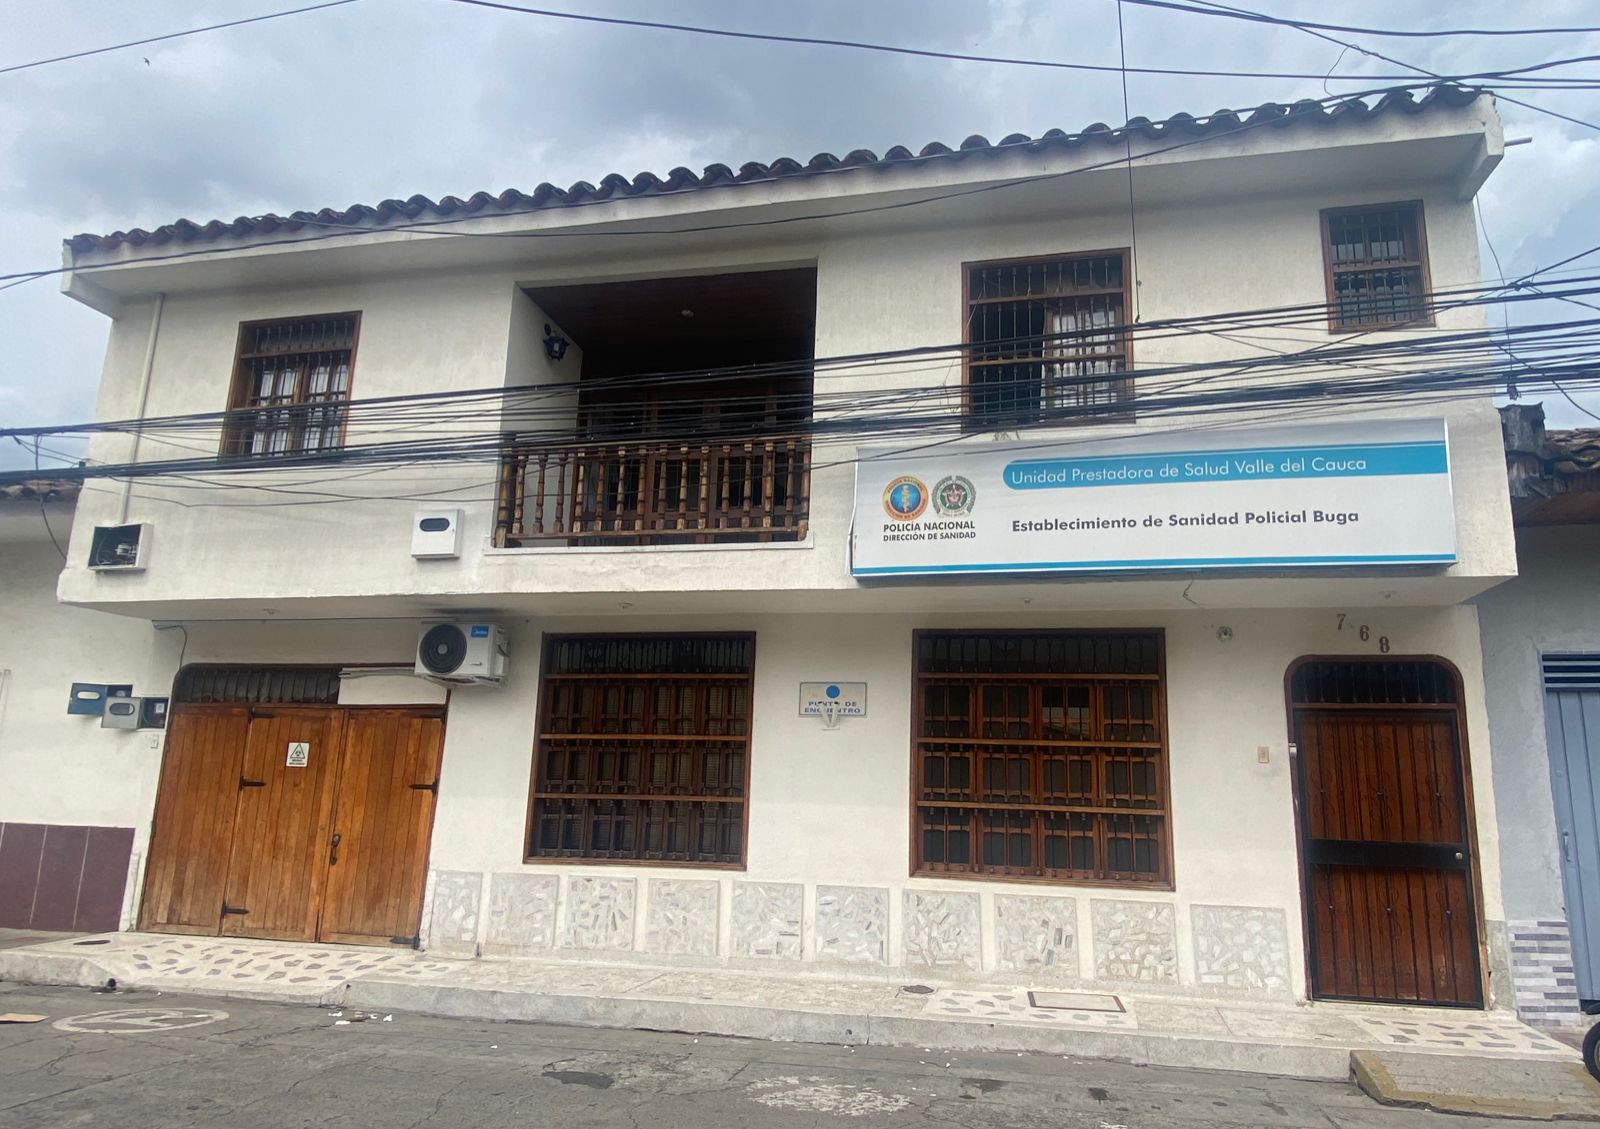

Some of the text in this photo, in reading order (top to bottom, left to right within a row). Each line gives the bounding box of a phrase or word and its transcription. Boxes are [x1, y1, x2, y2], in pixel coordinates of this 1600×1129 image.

[1011, 457, 1367, 485] Unidad Prestadora de Salud Valle del Cauca
[923, 520, 975, 531] NACIONAL
[1011, 510, 1359, 533] Establecimiento de Sanidad Policial Buga
[883, 531, 976, 542] DIRECCIÓN DE SANIDAD
